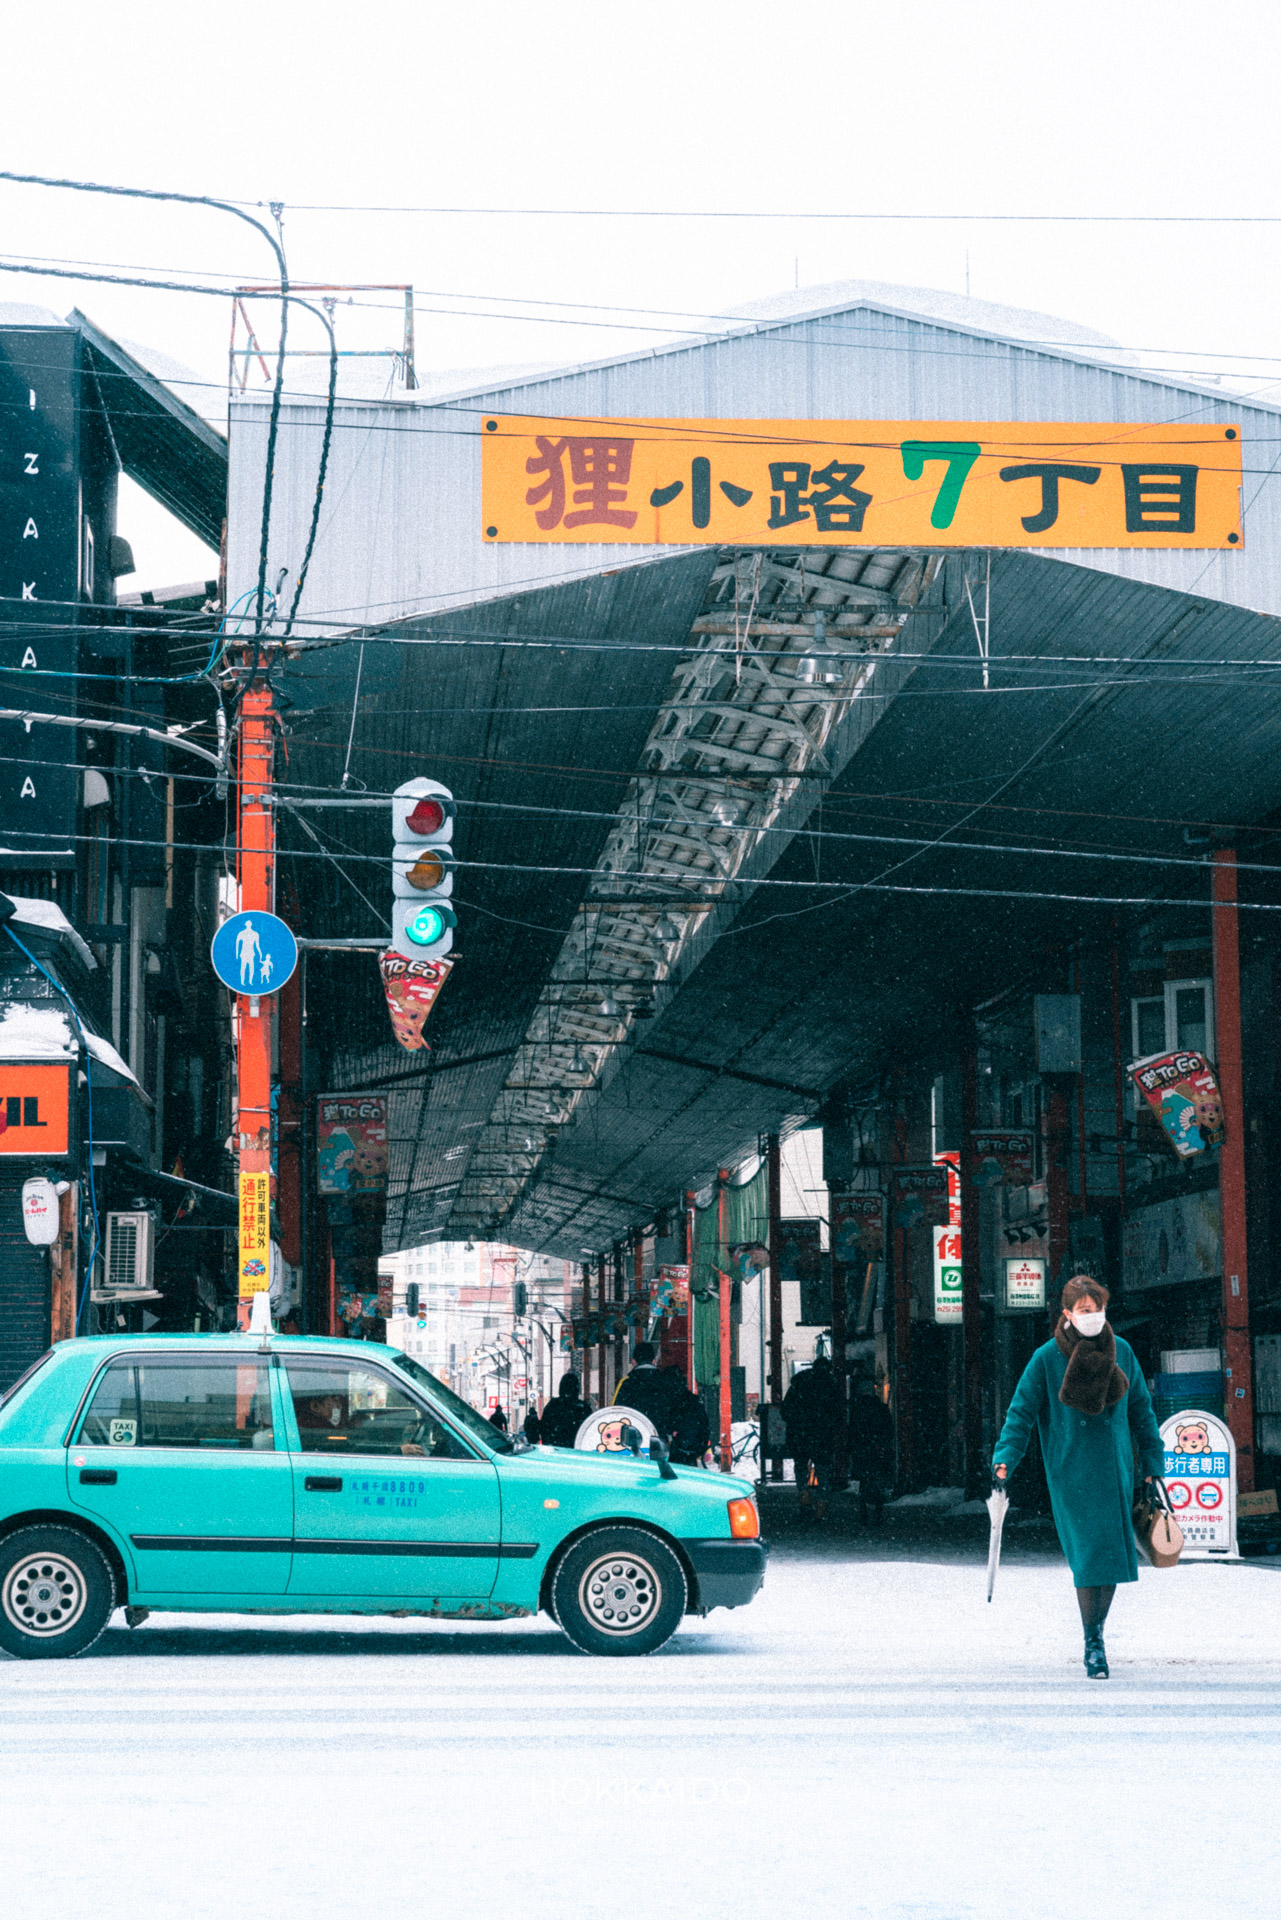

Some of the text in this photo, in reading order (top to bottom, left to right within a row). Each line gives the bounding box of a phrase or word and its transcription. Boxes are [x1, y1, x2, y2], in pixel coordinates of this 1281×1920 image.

[525, 435, 1198, 534] 狸小路7丁目
[0, 1097, 47, 1126] IL
[242, 1179, 256, 1249] 通行禁止
[257, 1179, 266, 1249] 許可車両以外
[395, 1497, 418, 1508] TAXI
